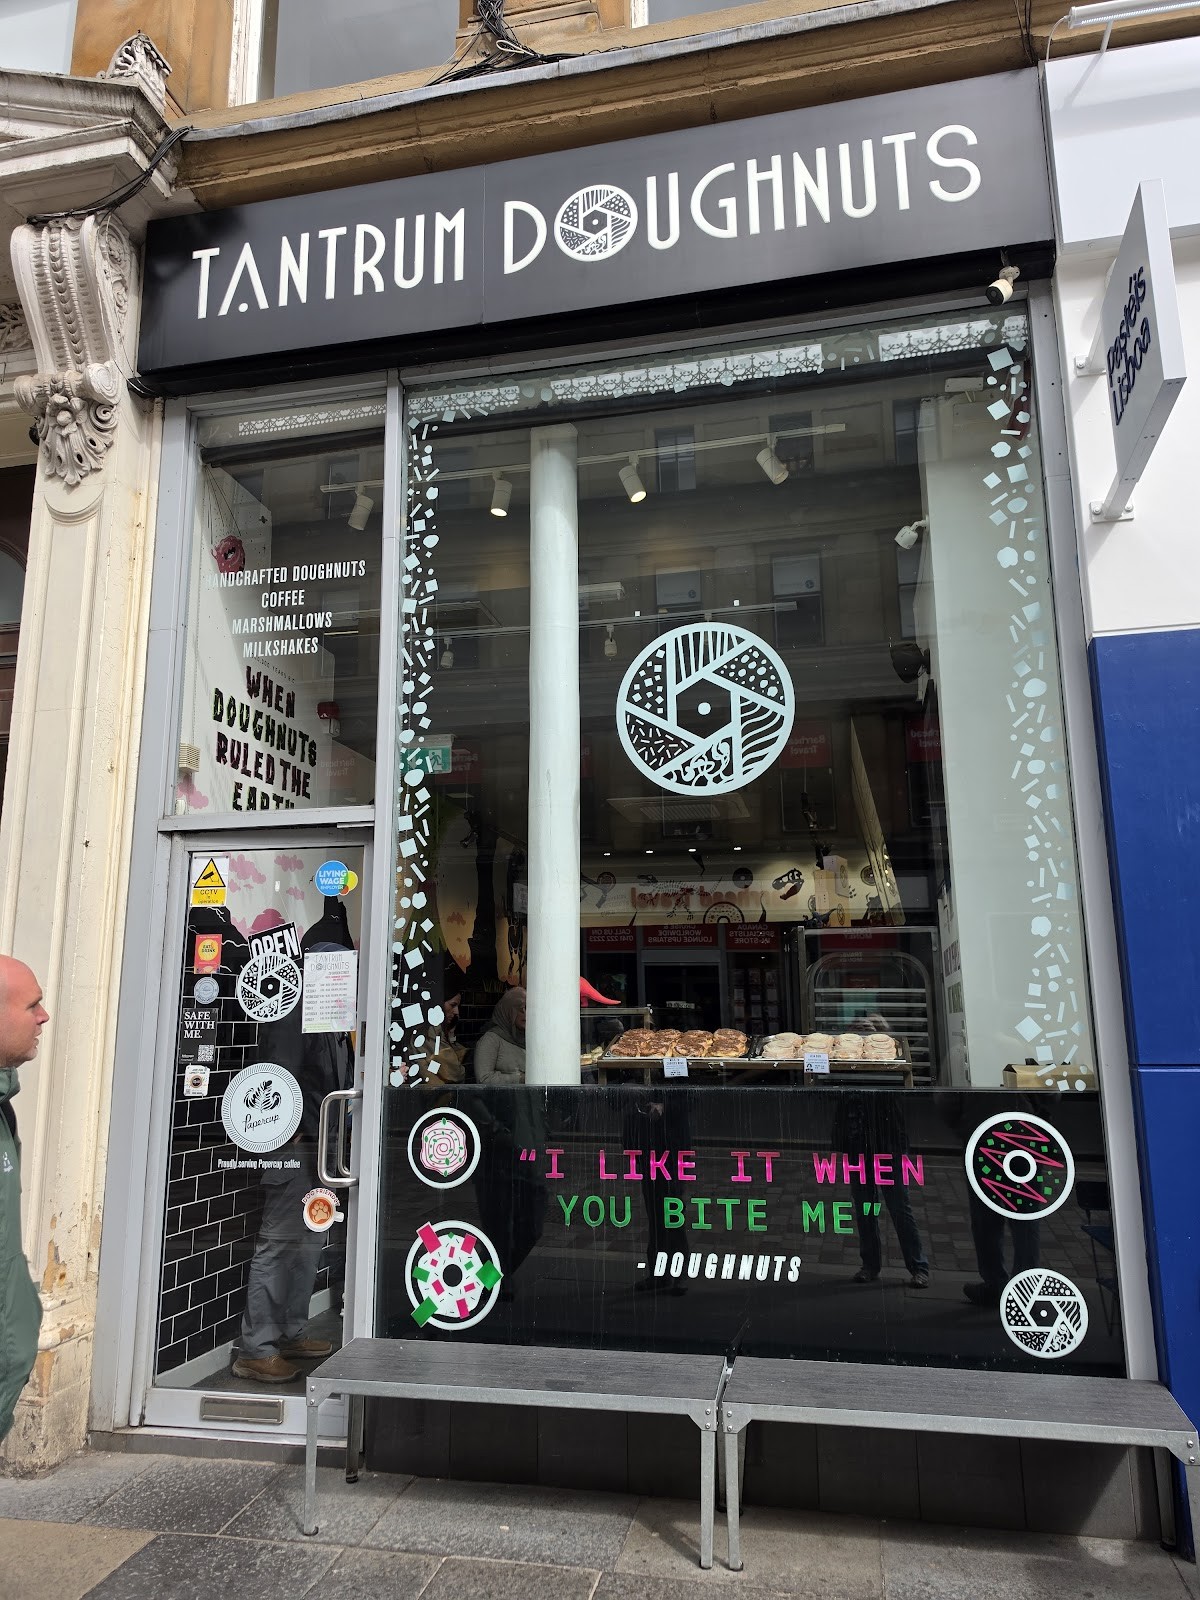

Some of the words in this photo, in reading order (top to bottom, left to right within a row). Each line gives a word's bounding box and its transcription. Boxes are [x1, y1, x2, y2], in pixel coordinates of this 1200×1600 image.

[192, 207, 465, 319] TANTRUM
[503, 124, 982, 275] DOUGHNUTS
[1112, 316, 1151, 426] Lisboa
[292, 560, 367, 582] DOUGHNUTS
[261, 589, 305, 608] COFFEE
[232, 611, 333, 635] MARSHMALLOWS
[243, 636, 319, 659] MILKSHAKES
[246, 665, 296, 719] WHEN
[212, 687, 318, 768] DOUGHNUTS
[216, 731, 275, 785] RULED
[279, 757, 312, 800] THE
[318, 869, 347, 878] LIVING
[319, 877, 345, 885] WAGE
[250, 925, 300, 959] OPEN
[310, 962, 350, 972] DOUGHNUTS
[183, 1020, 216, 1030] WITH
[184, 1011, 211, 1021] SAFE
[183, 1029, 203, 1039] ME.
[242, 1113, 280, 1133] Papercup
[217, 1158, 237, 1169] Proudly
[238, 1159, 258, 1169] serving
[258, 1158, 283, 1169] Papercup
[284, 1158, 301, 1169] coffee
[598, 1148, 697, 1181] LIKE
[730, 1150, 781, 1184] IT
[813, 1152, 925, 1188] WHEN
[302, 1190, 315, 1203] DOG
[315, 1188, 340, 1206] FRIENDLY
[557, 1194, 632, 1229] YOU
[664, 1197, 768, 1232] BITE
[653, 1251, 802, 1283] DOUGHNUTS
